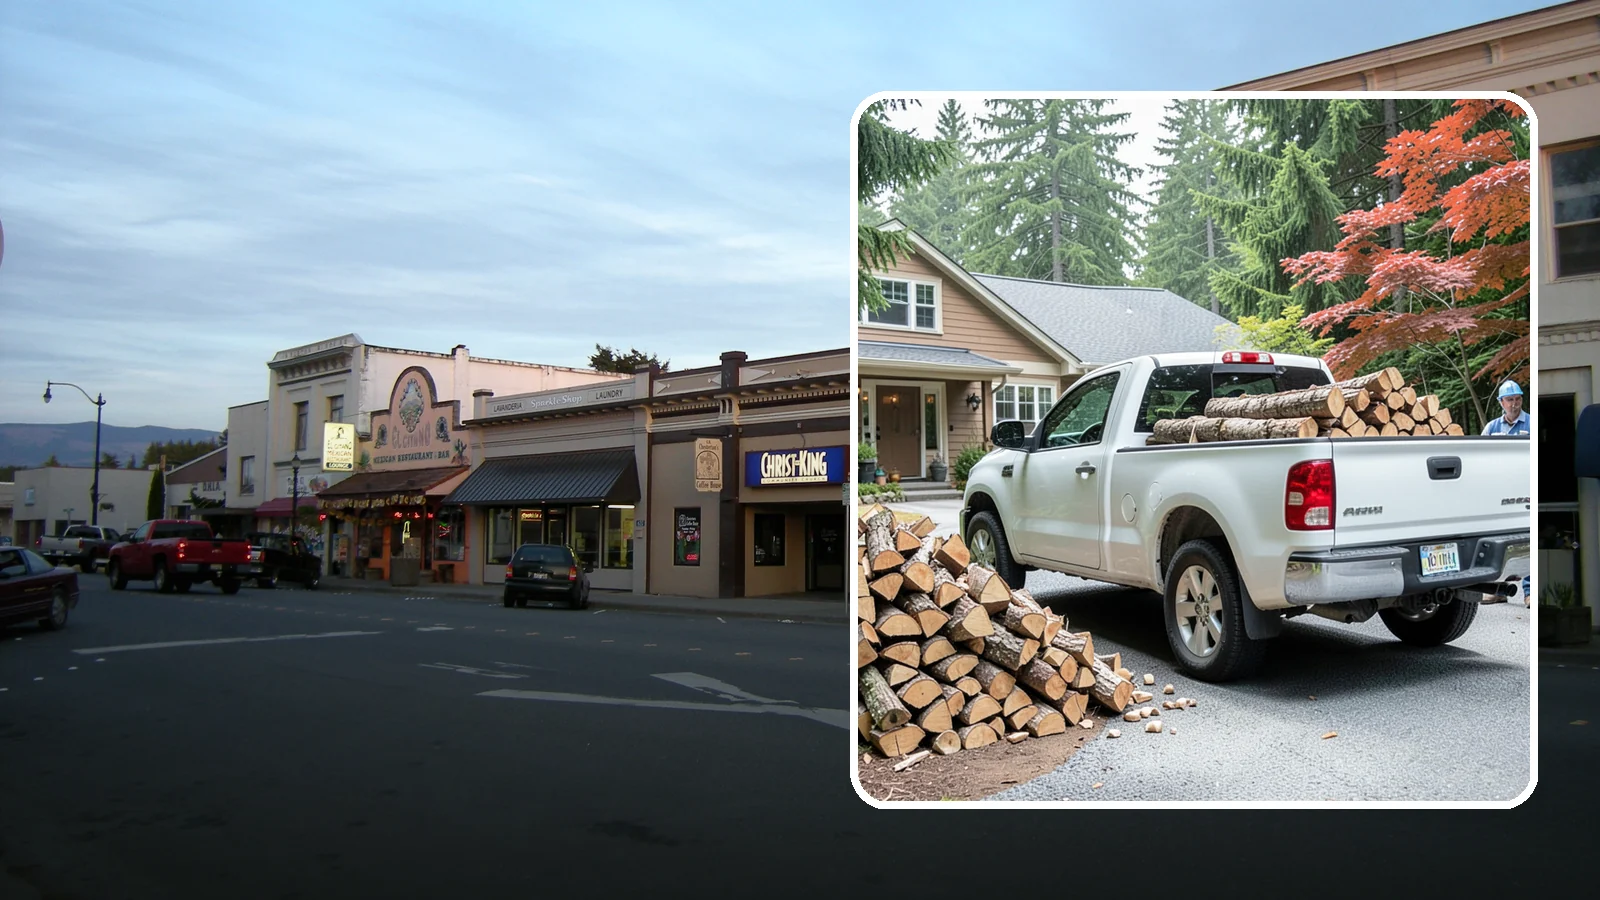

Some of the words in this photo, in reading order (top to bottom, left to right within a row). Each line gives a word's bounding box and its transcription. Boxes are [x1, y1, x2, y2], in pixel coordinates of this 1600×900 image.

[493, 402, 523, 412] LAVANDERIA
[531, 396, 561, 408] Sparkle
[562, 394, 582, 405] Shop
[595, 389, 624, 400] LAUNDRY
[373, 455, 396, 464] MEXICAN
[397, 451, 433, 462] RESTAURANT
[438, 450, 450, 459] BAR
[761, 452, 797, 478] CHRIST
[799, 449, 827, 476] KING
